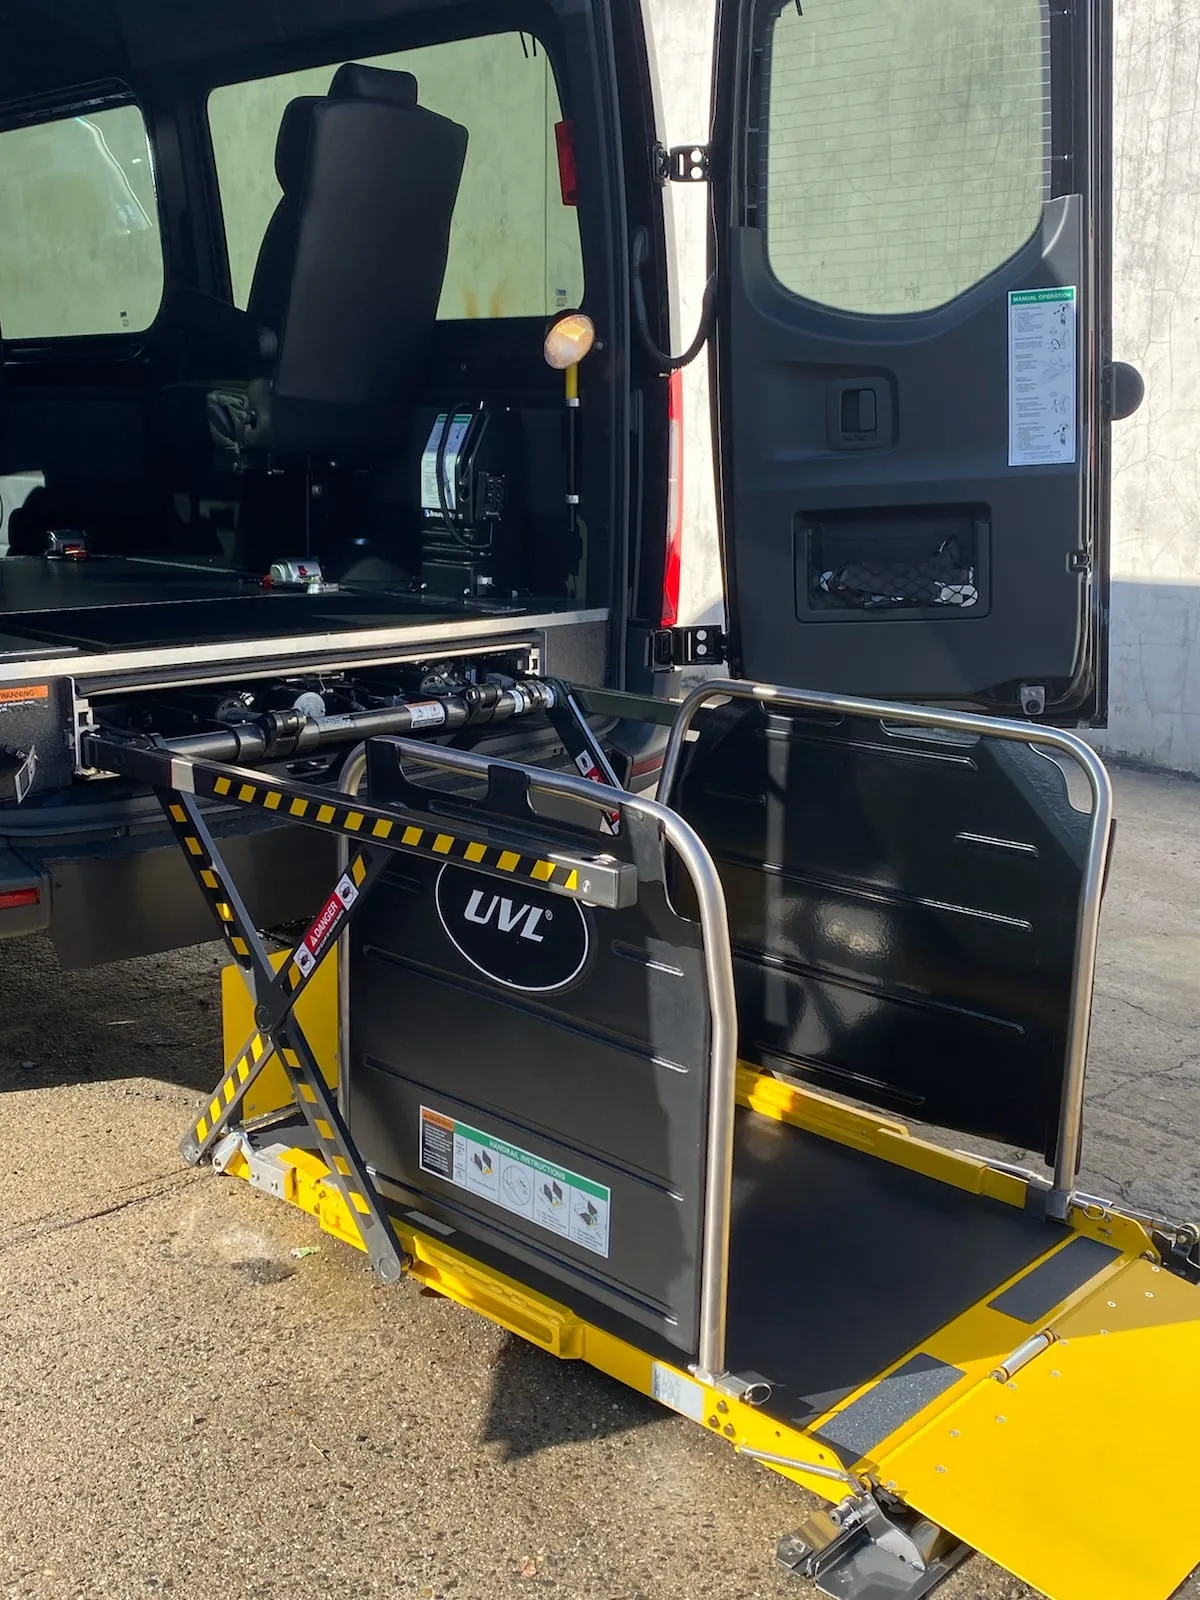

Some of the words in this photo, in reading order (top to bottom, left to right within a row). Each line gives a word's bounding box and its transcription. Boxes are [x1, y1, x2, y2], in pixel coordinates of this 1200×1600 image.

[1038, 291, 1072, 300] OPERATION
[313, 901, 338, 938] DANGER
[489, 1140, 520, 1161] HANDRAIL
[519, 1155, 566, 1181] INSTRUCTIONS
